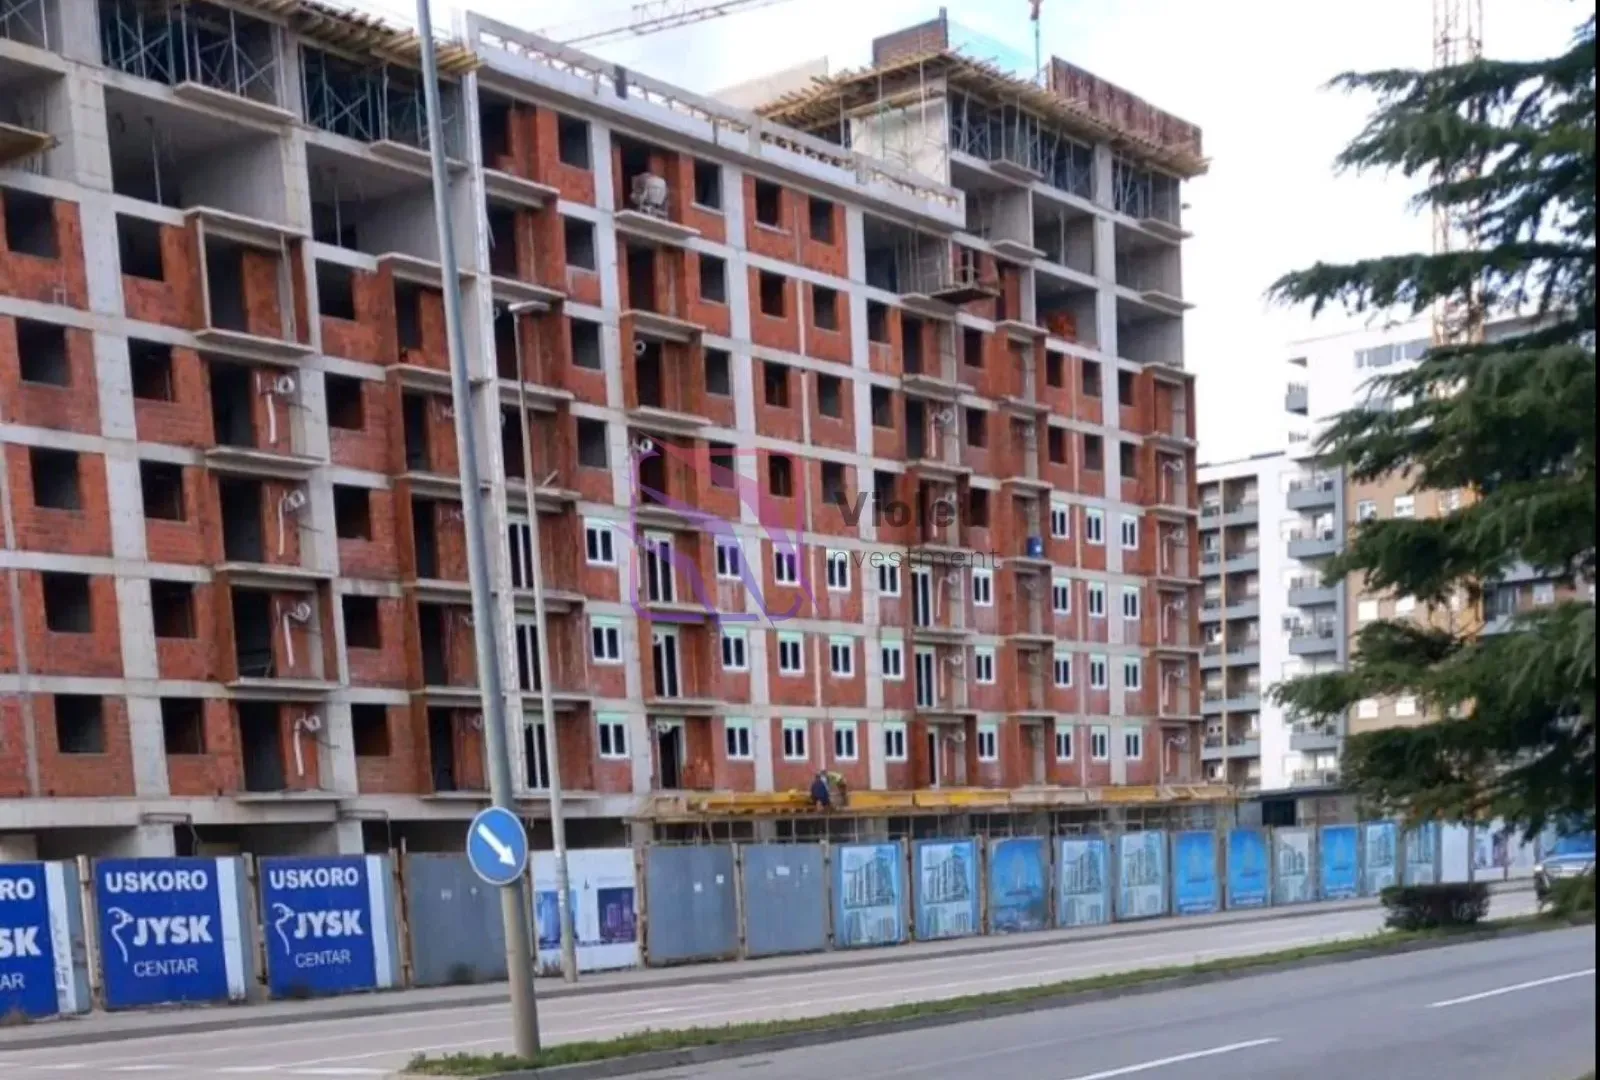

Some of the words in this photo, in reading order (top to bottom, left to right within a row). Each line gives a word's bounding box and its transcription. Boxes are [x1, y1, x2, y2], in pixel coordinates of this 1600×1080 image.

[104, 869, 209, 893] USKORO
[269, 866, 360, 890] USKORO
[132, 914, 214, 947] JYSK
[293, 909, 364, 940] JYSK
[133, 957, 200, 977] CENTAR
[294, 948, 352, 968] CENTAR
